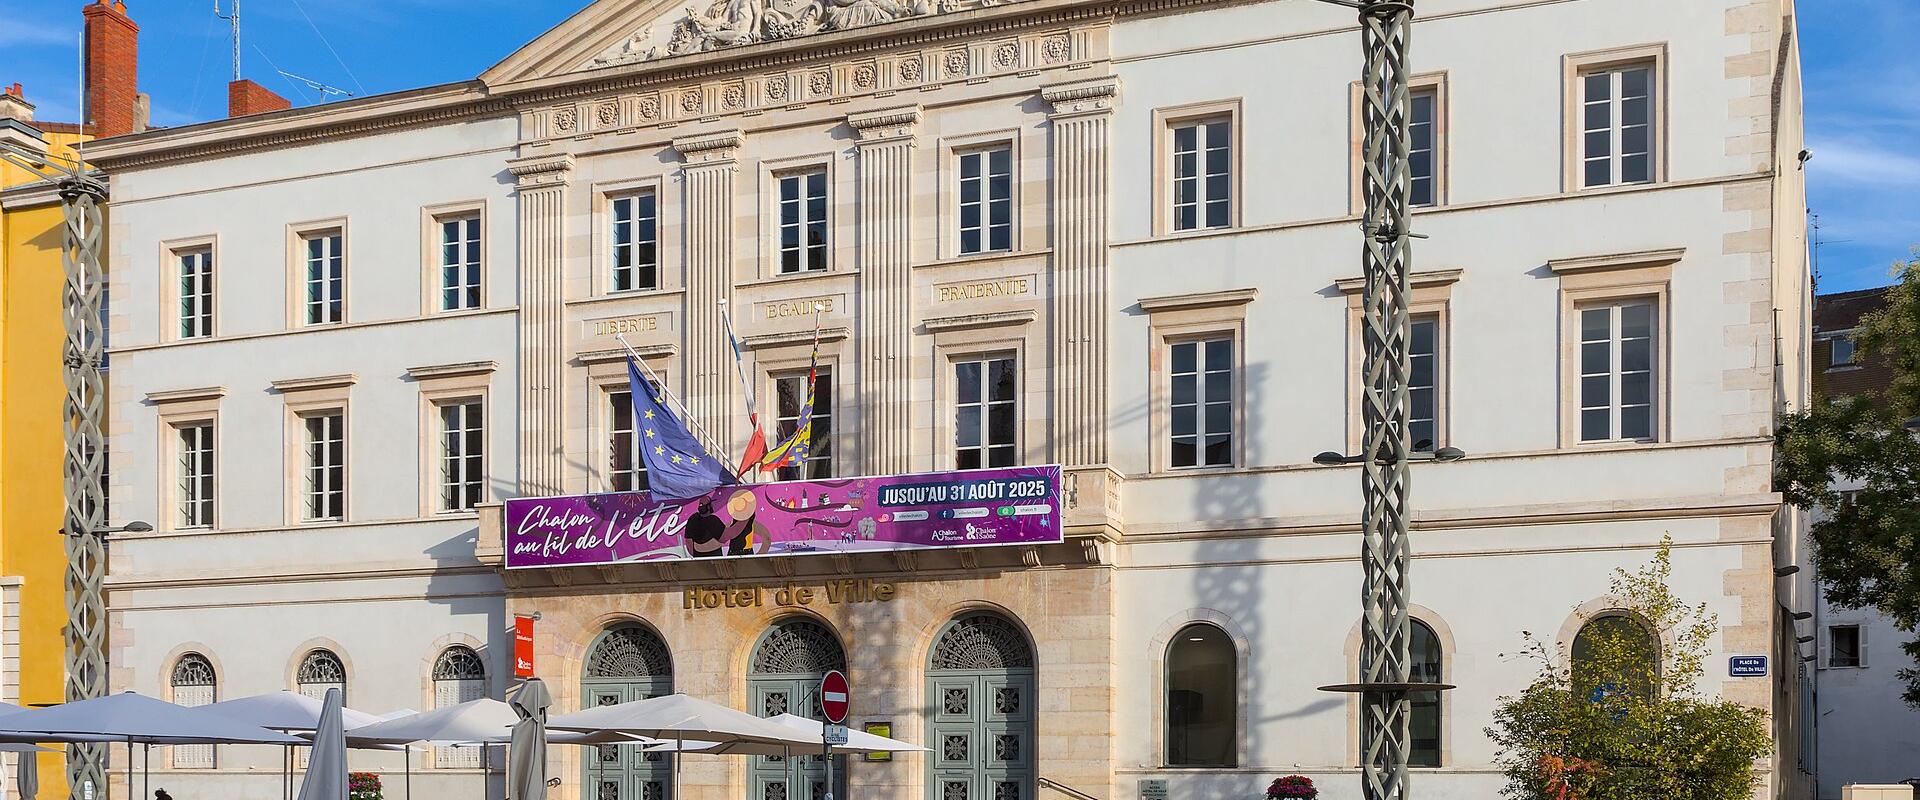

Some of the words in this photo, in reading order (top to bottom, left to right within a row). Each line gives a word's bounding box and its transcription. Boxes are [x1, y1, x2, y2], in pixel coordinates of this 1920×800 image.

[939, 279, 1028, 302] FRATERNITE
[594, 316, 657, 336] LIBERTE
[882, 486, 947, 505] JUSQU'AU
[950, 485, 965, 501] 31
[967, 480, 1006, 500] AOÛT
[1008, 480, 1045, 498] 2025
[517, 504, 596, 536] Chalon
[975, 526, 997, 535] Chalon
[514, 539, 543, 555] au
[543, 531, 573, 558] fil
[575, 526, 603, 550] de
[775, 581, 815, 607] de
[824, 578, 896, 605] Ville
